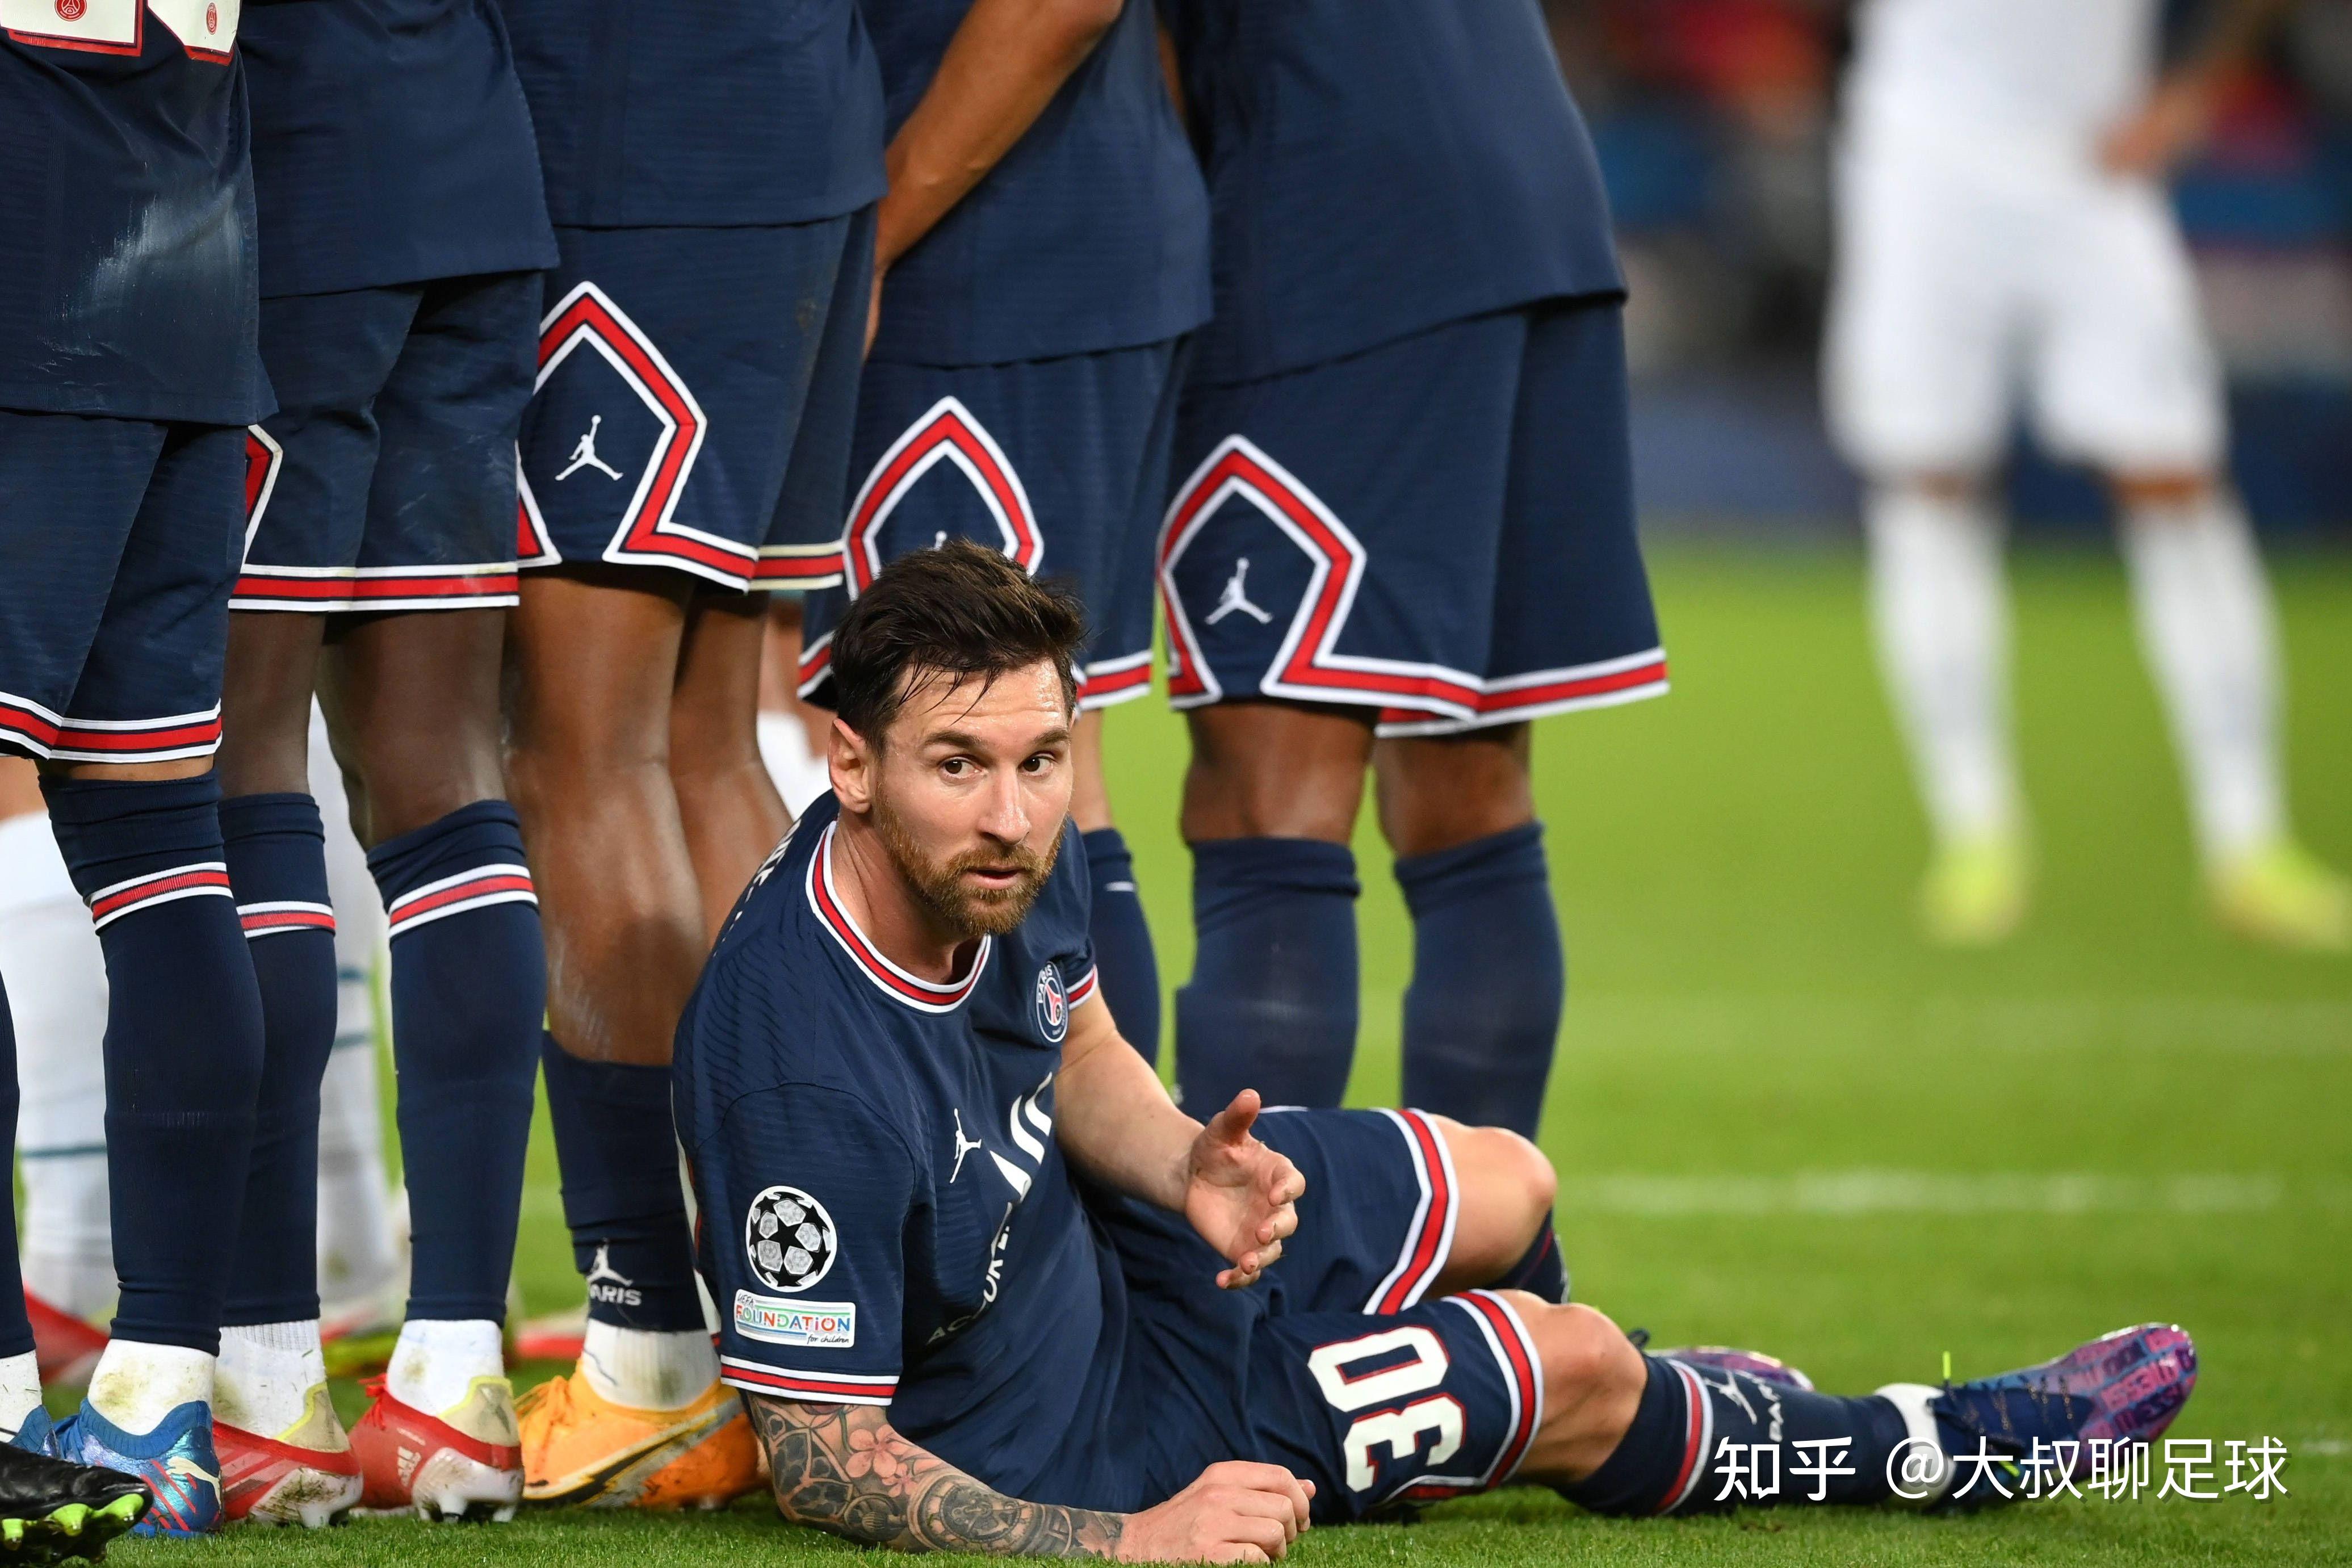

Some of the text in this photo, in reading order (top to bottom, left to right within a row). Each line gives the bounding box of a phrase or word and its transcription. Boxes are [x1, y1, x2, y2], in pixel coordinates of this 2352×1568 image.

[589, 1283, 642, 1306] ARIS
[737, 1293, 754, 1306] UEFA
[807, 1334, 849, 1345] for children
[1307, 1324, 1467, 1493] 30
